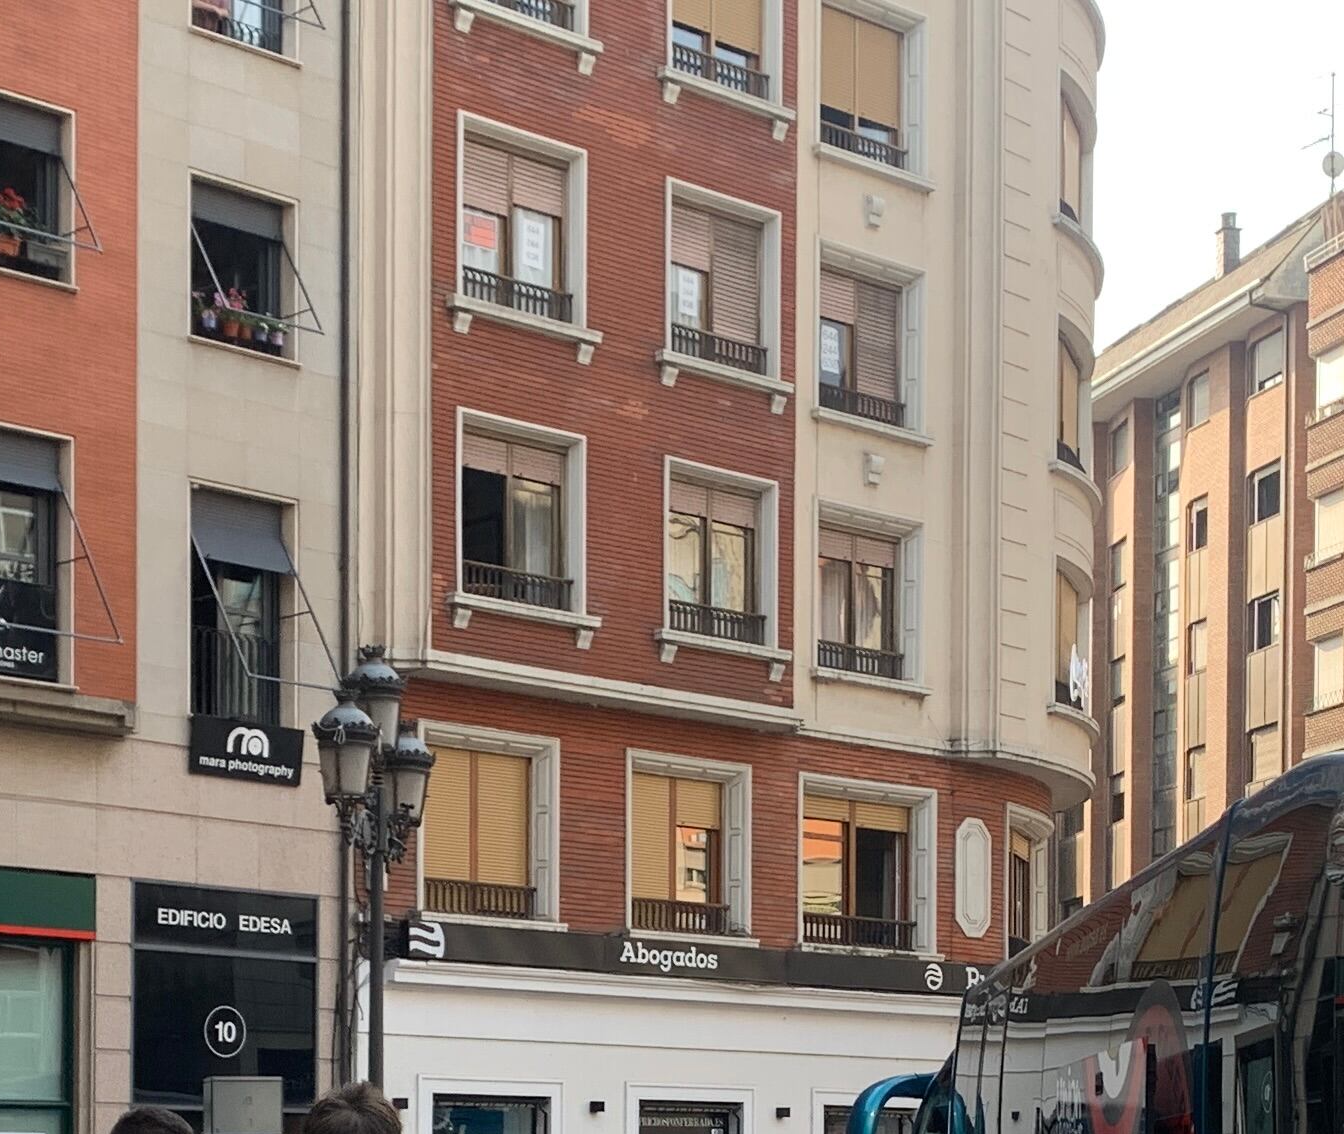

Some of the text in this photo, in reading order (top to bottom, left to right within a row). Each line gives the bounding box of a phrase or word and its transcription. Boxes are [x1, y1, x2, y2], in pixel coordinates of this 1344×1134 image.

[199, 756, 294, 779] mara photography
[157, 907, 293, 935] EDIFICIO EDESA
[619, 941, 719, 972] Abogados
[214, 1020, 237, 1043] 10
